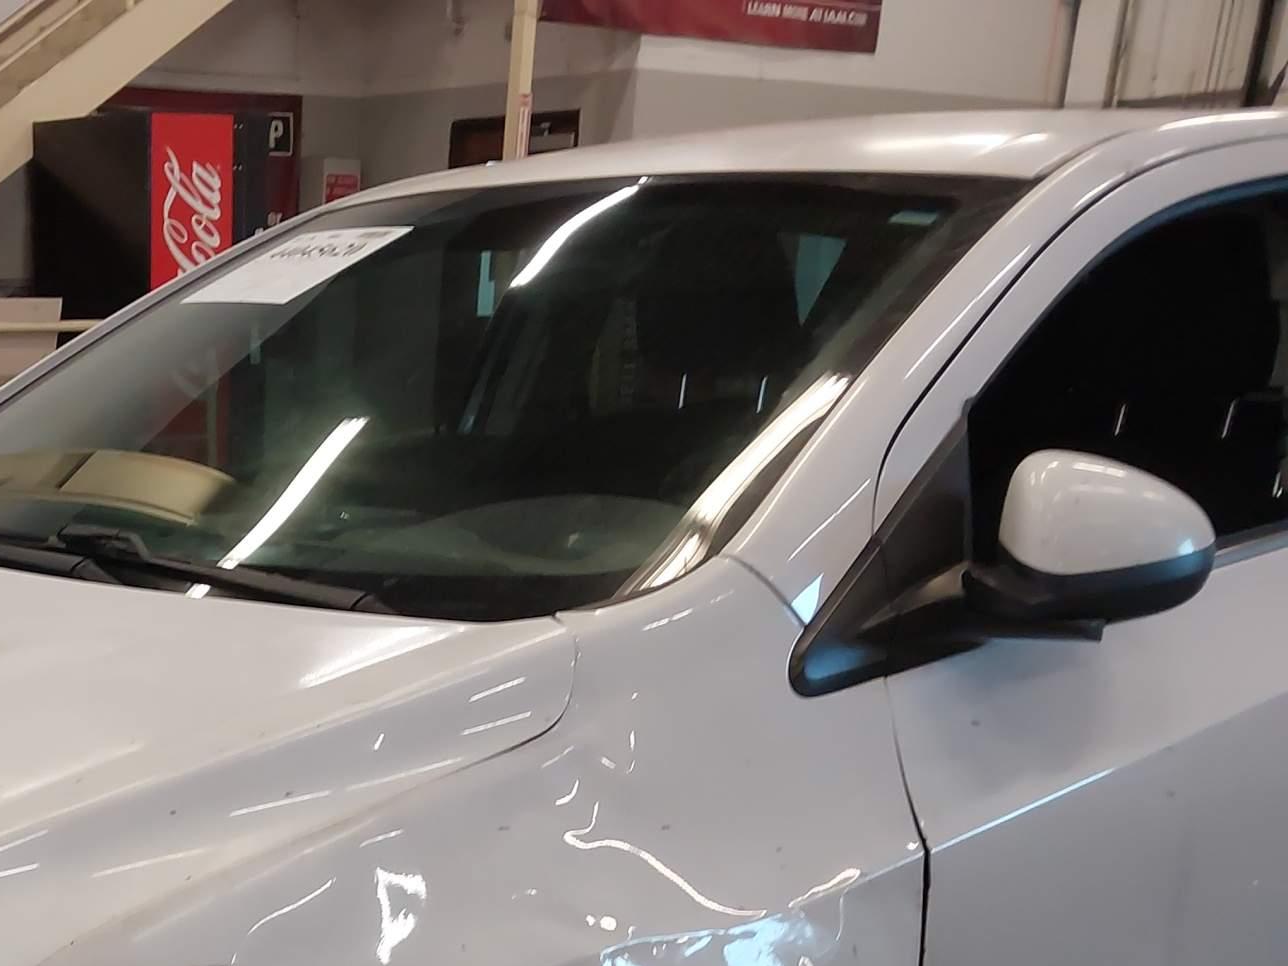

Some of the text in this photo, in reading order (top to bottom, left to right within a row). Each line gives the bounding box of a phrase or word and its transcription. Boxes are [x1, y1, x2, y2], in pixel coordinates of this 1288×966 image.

[747, 1, 781, 17] LEARN
[782, 5, 808, 21] MORE
[809, 8, 823, 22] AT
